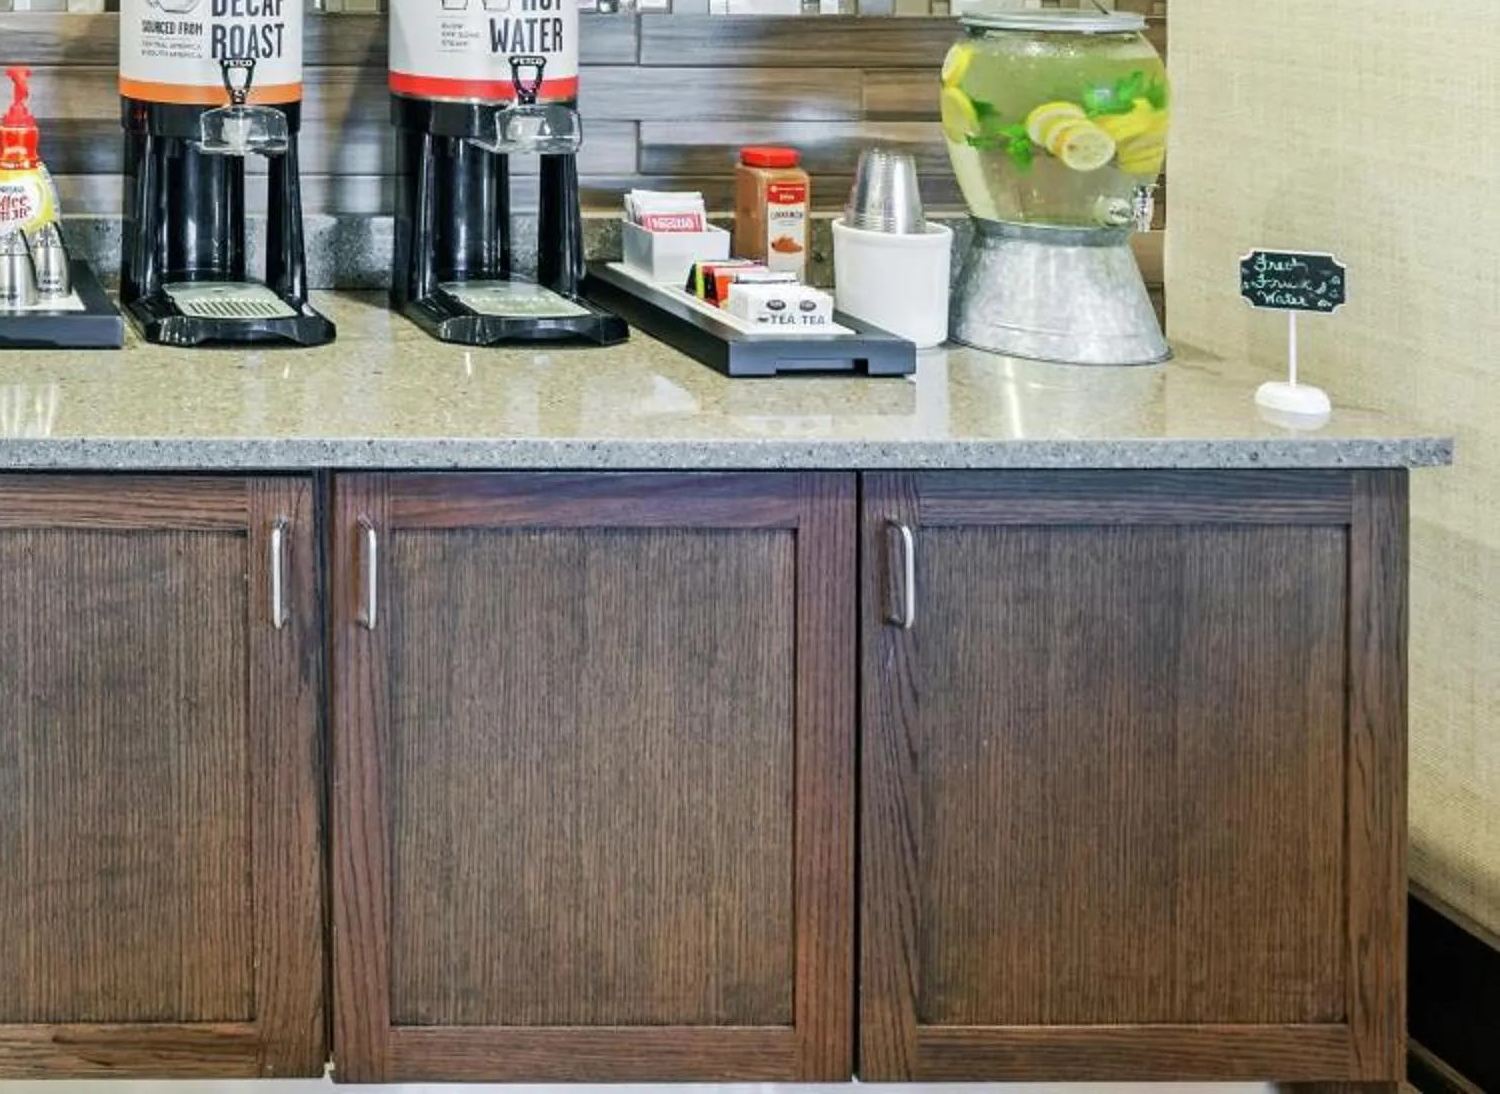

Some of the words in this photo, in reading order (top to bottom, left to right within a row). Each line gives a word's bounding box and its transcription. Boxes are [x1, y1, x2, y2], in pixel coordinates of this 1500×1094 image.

[211, 22, 285, 59] ROAST
[489, 17, 564, 54] WATER
[223, 58, 254, 66] FETCO
[771, 314, 796, 325] TEA
[802, 314, 825, 326] TEA
